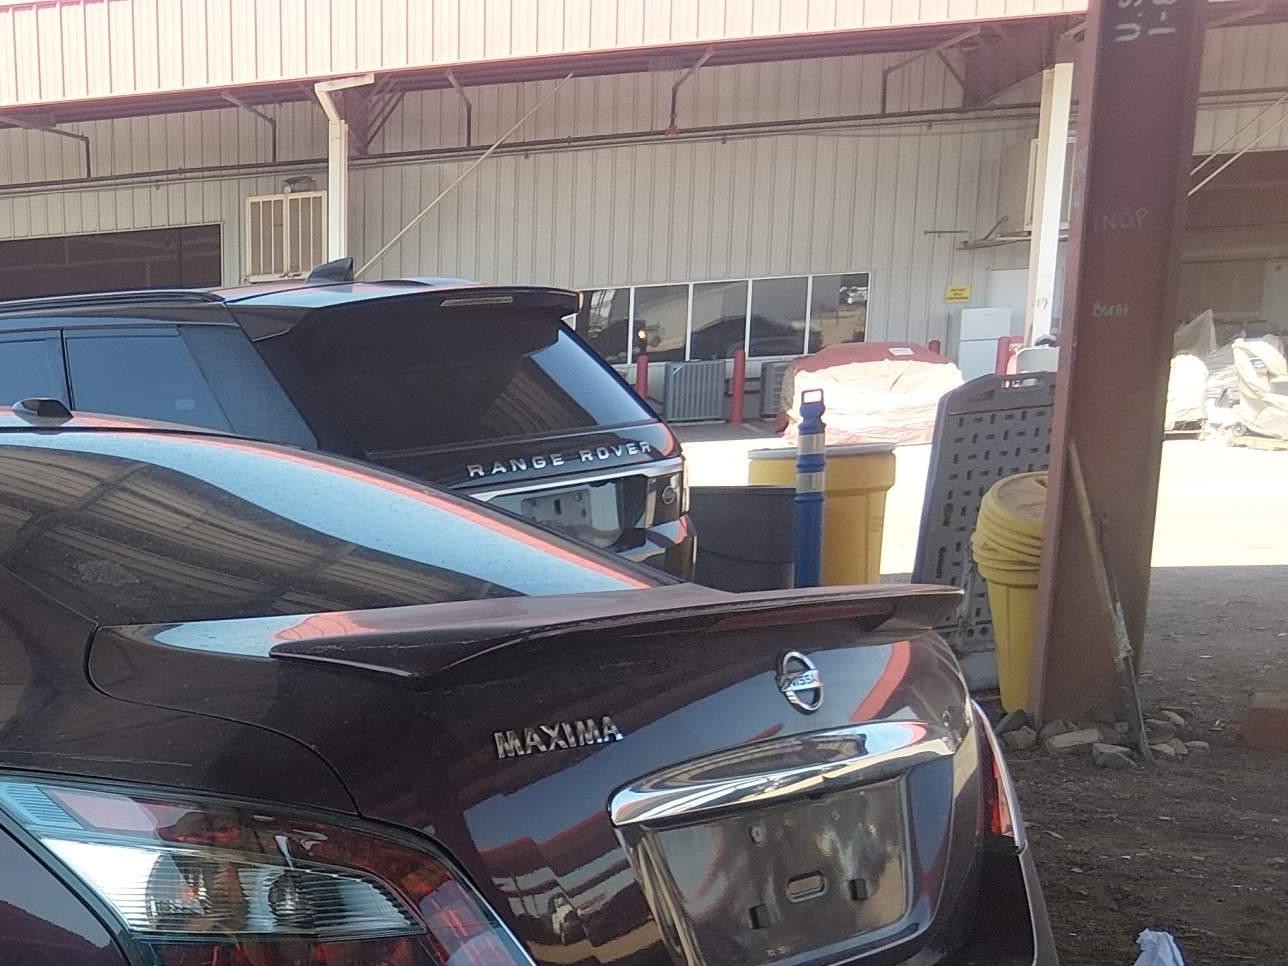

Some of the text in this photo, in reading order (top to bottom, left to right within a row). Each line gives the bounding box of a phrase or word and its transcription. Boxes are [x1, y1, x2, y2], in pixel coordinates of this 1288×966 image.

[467, 441, 652, 477] RANGE ROVER
[494, 716, 624, 759] MAXIMA
